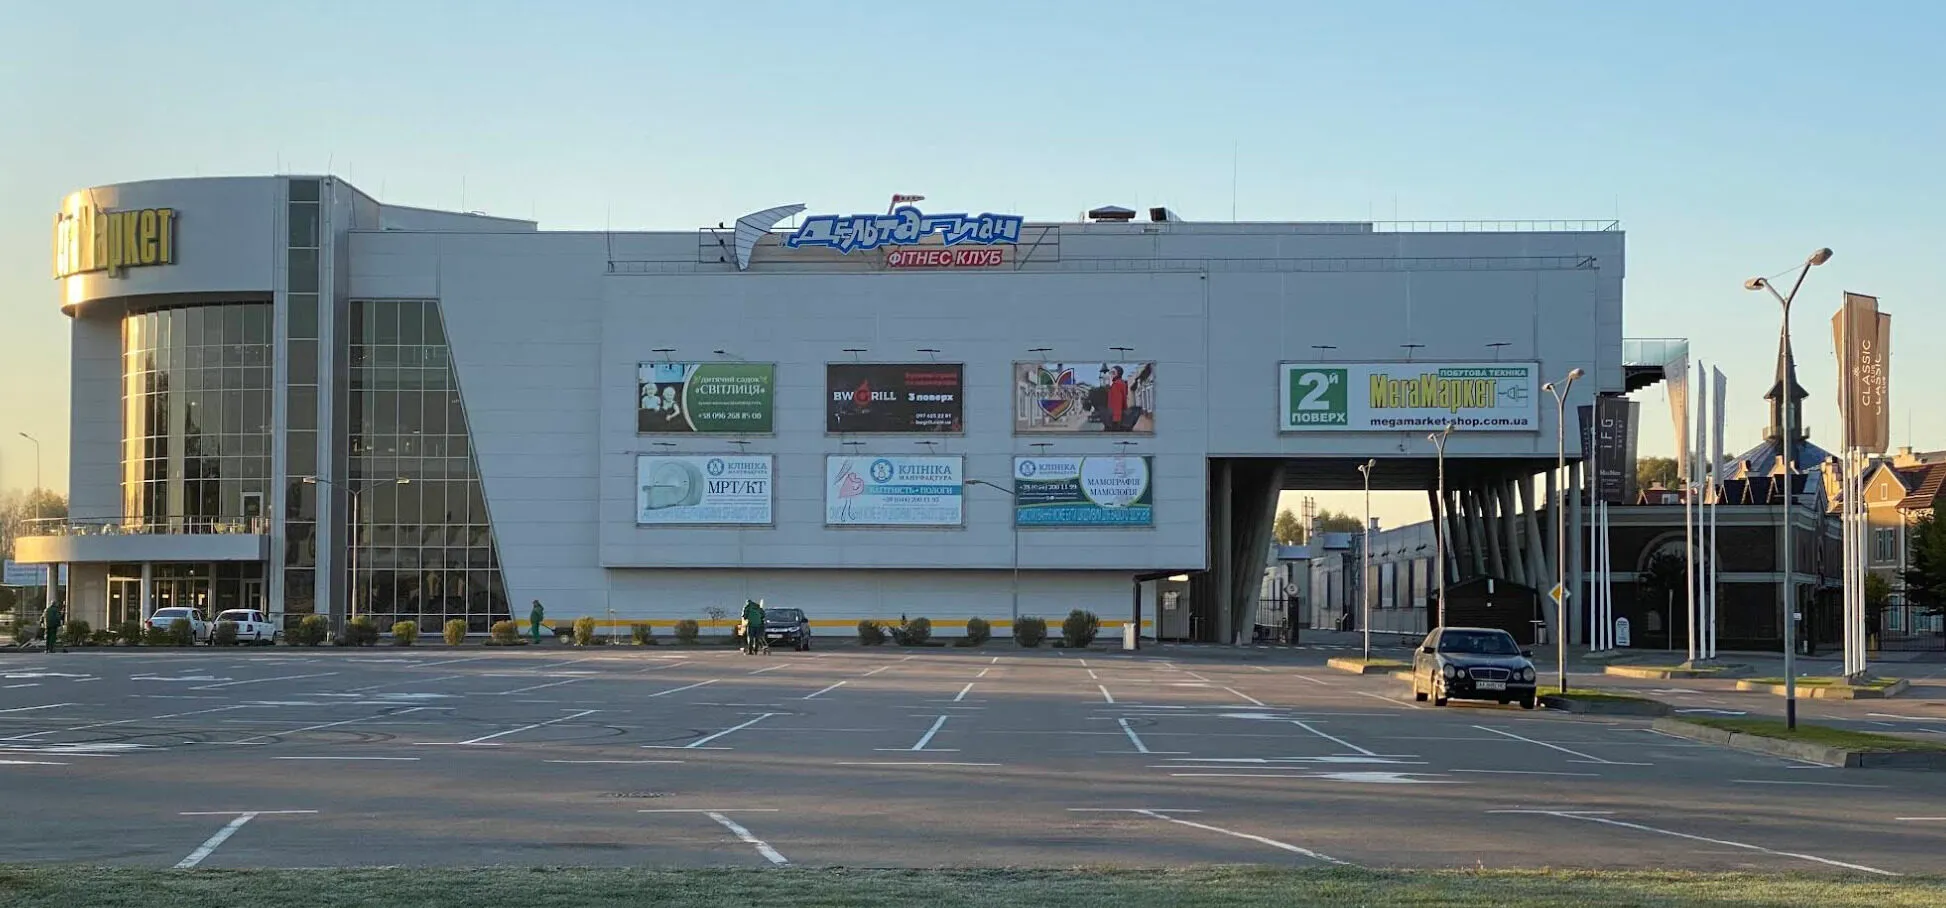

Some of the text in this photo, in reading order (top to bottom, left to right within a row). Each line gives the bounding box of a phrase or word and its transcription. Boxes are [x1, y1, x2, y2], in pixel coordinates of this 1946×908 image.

[888, 249, 1002, 266] ФІТНЕС КЛУБ
[1440, 368, 1526, 377] ПОБУТОВА ТЕХНІКА
[1862, 340, 1871, 406] CLASSIC
[833, 391, 854, 400] BW
[908, 393, 954, 403] 3 поверх
[1369, 373, 1497, 414] МегаМаркет
[1291, 412, 1346, 423] ПОВЕРХ
[1370, 417, 1528, 428] megamarket-shop.com.ua
[899, 465, 952, 475] КЛІНІКА
[708, 480, 766, 494] МРТ/КТ
